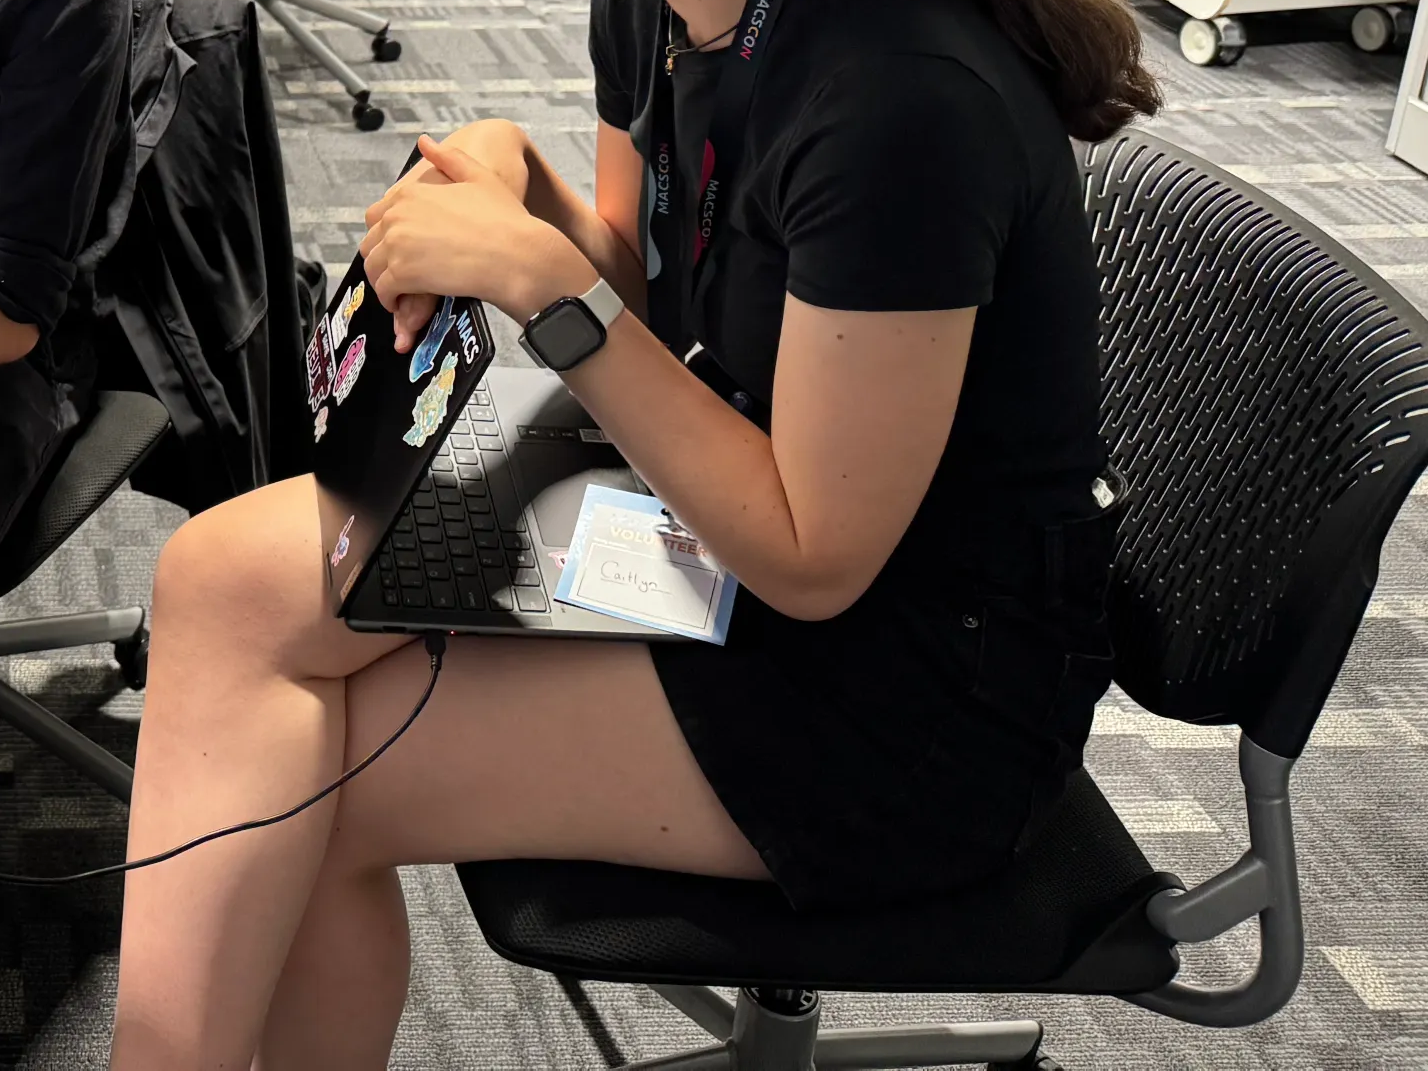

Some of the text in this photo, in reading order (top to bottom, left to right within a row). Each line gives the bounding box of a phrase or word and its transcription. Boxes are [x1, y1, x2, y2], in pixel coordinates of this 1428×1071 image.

[657, 142, 670, 215] MACSCON
[701, 179, 720, 249] MACSCON
[455, 309, 480, 365] MACS
[600, 560, 658, 593] Caitlyn
